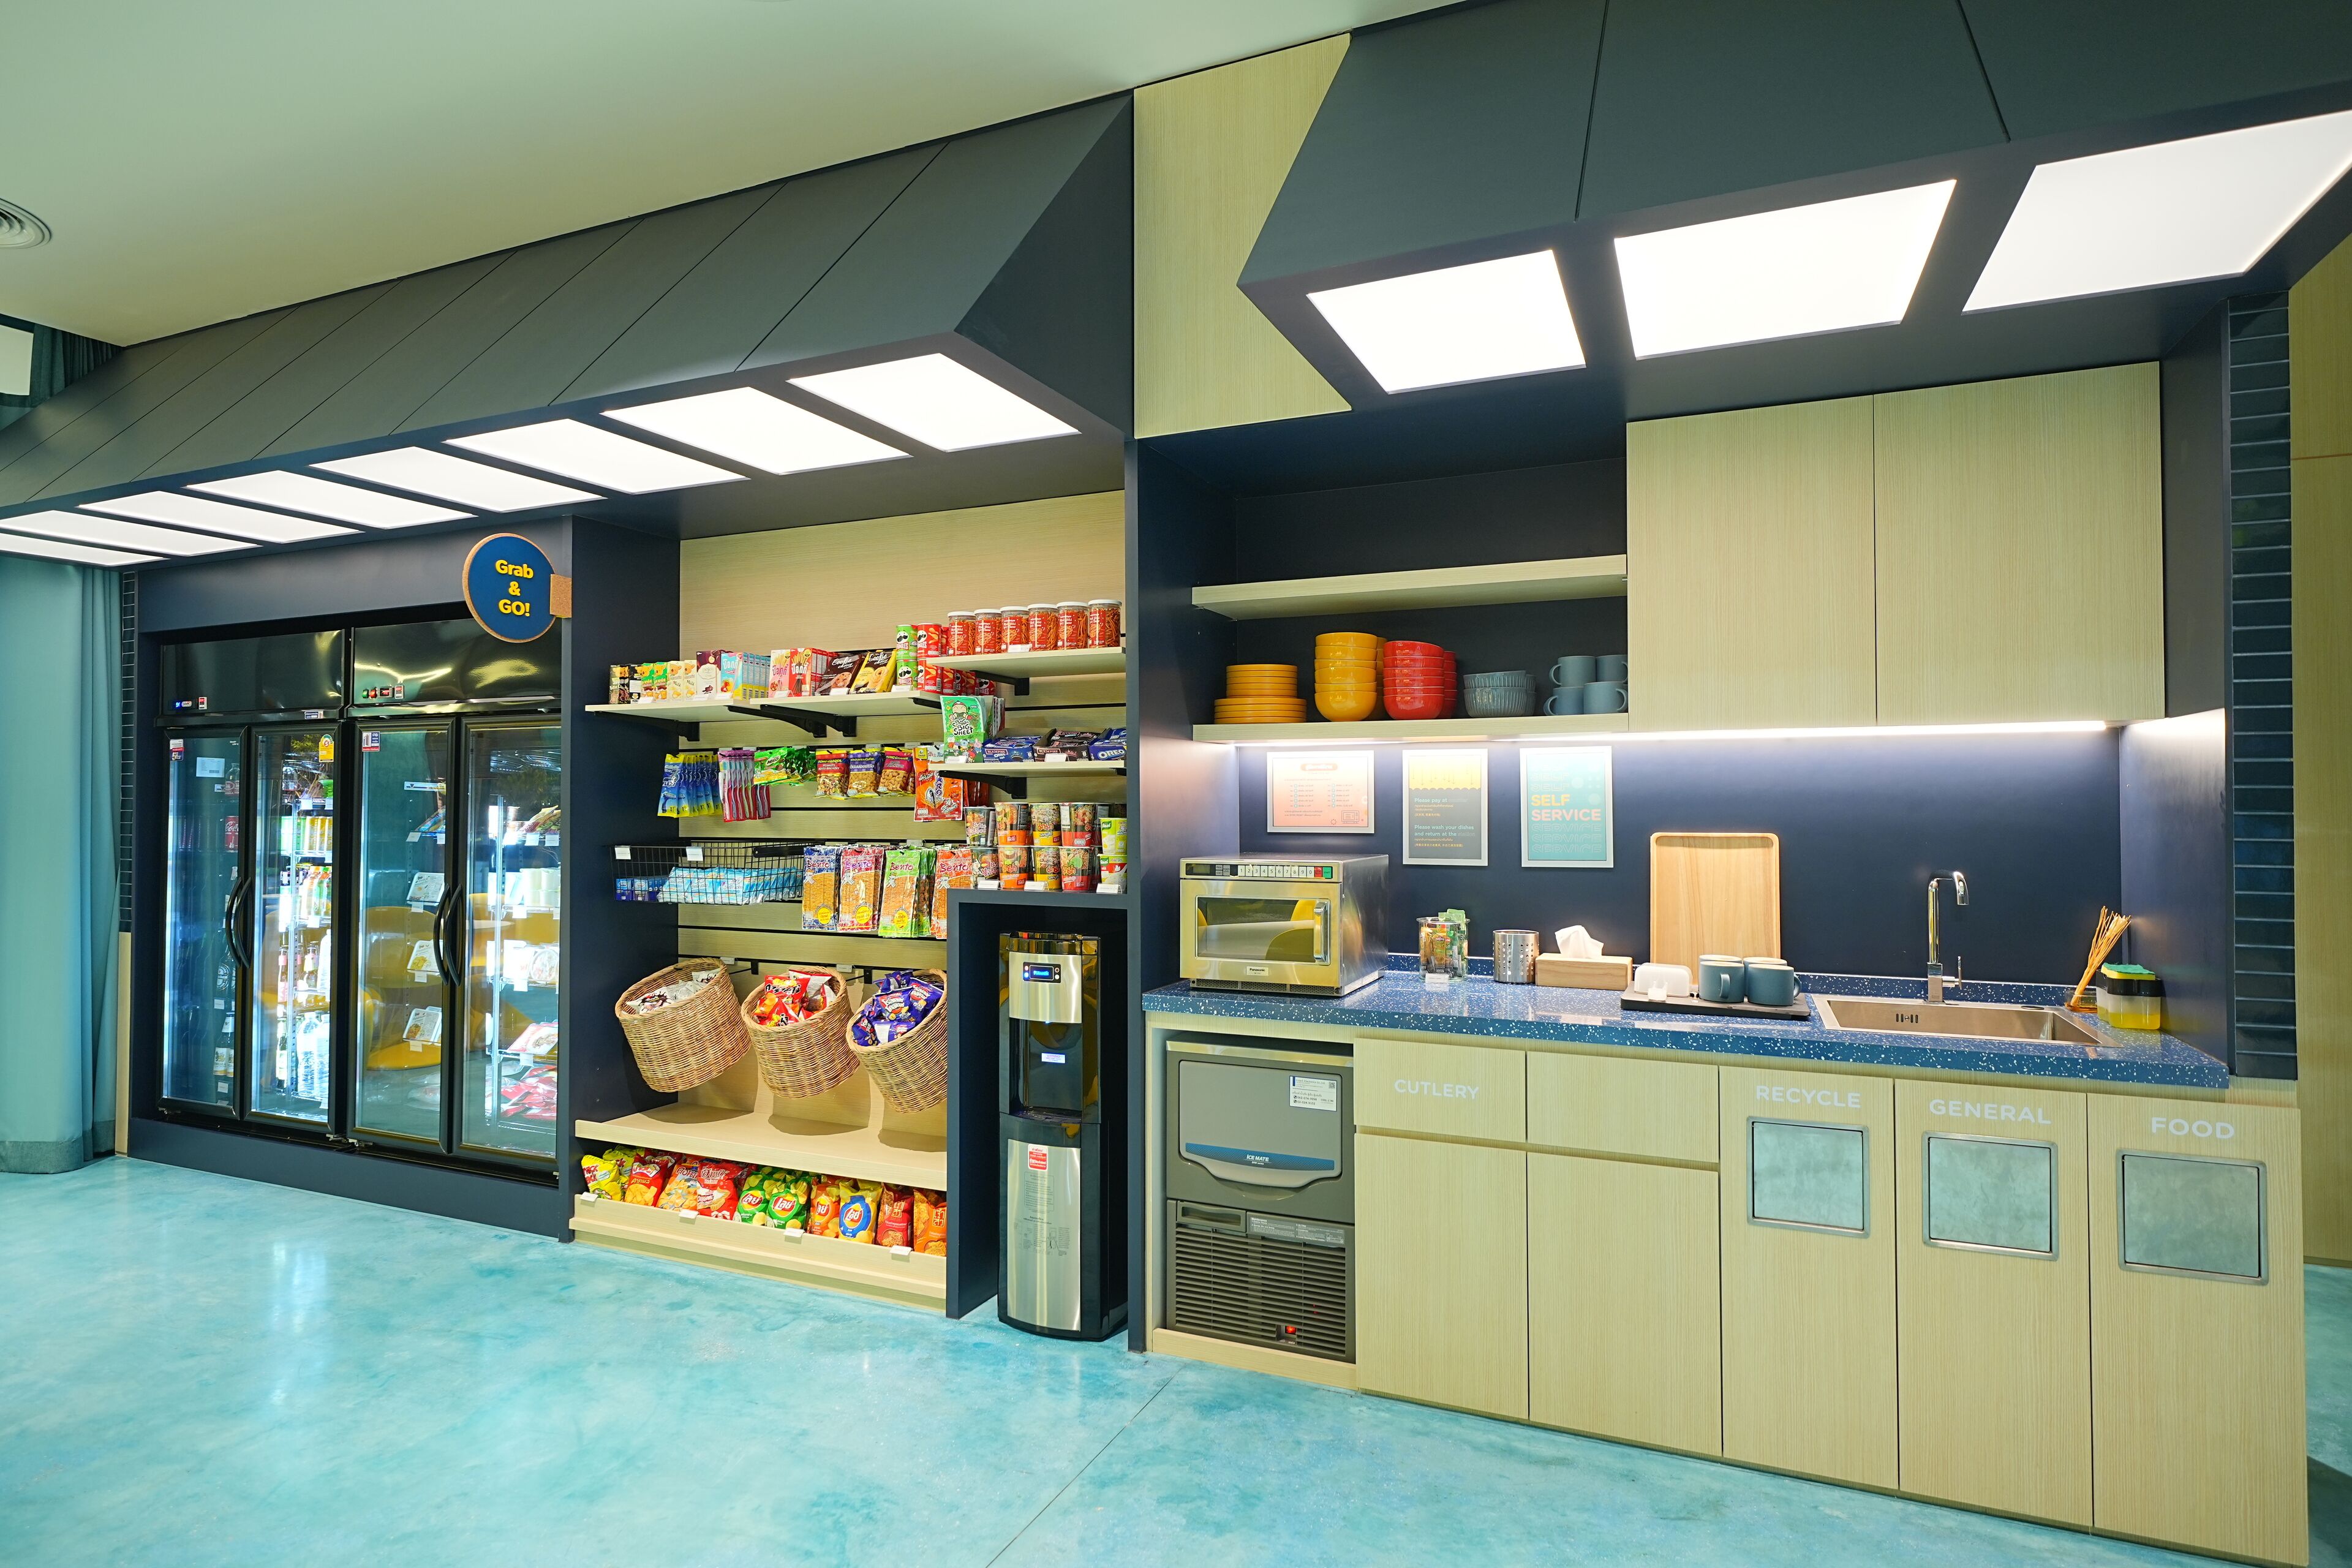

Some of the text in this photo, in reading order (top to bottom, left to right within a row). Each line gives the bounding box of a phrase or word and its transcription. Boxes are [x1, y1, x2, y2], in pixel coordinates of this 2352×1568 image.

[495, 560, 534, 579] Grab
[508, 581, 521, 597] &
[498, 599, 530, 617] GO!
[832, 656, 853, 666] Cookie
[869, 652, 888, 662] Cookie
[954, 727, 973, 736] SHEET
[1098, 748, 1125, 760] OREO
[1531, 794, 1570, 806] SELF
[1532, 809, 1602, 821] SERVICE
[807, 858, 831, 868] Bento
[845, 859, 872, 869] Bento
[890, 862, 914, 871] Bento
[940, 862, 969, 873] Bento
[1394, 1079, 1479, 1099] CUTLERY
[1756, 1085, 1861, 1108] RECYCLE
[1929, 1099, 2052, 1124] GENERAL
[2151, 1117, 2234, 1139] FOOD
